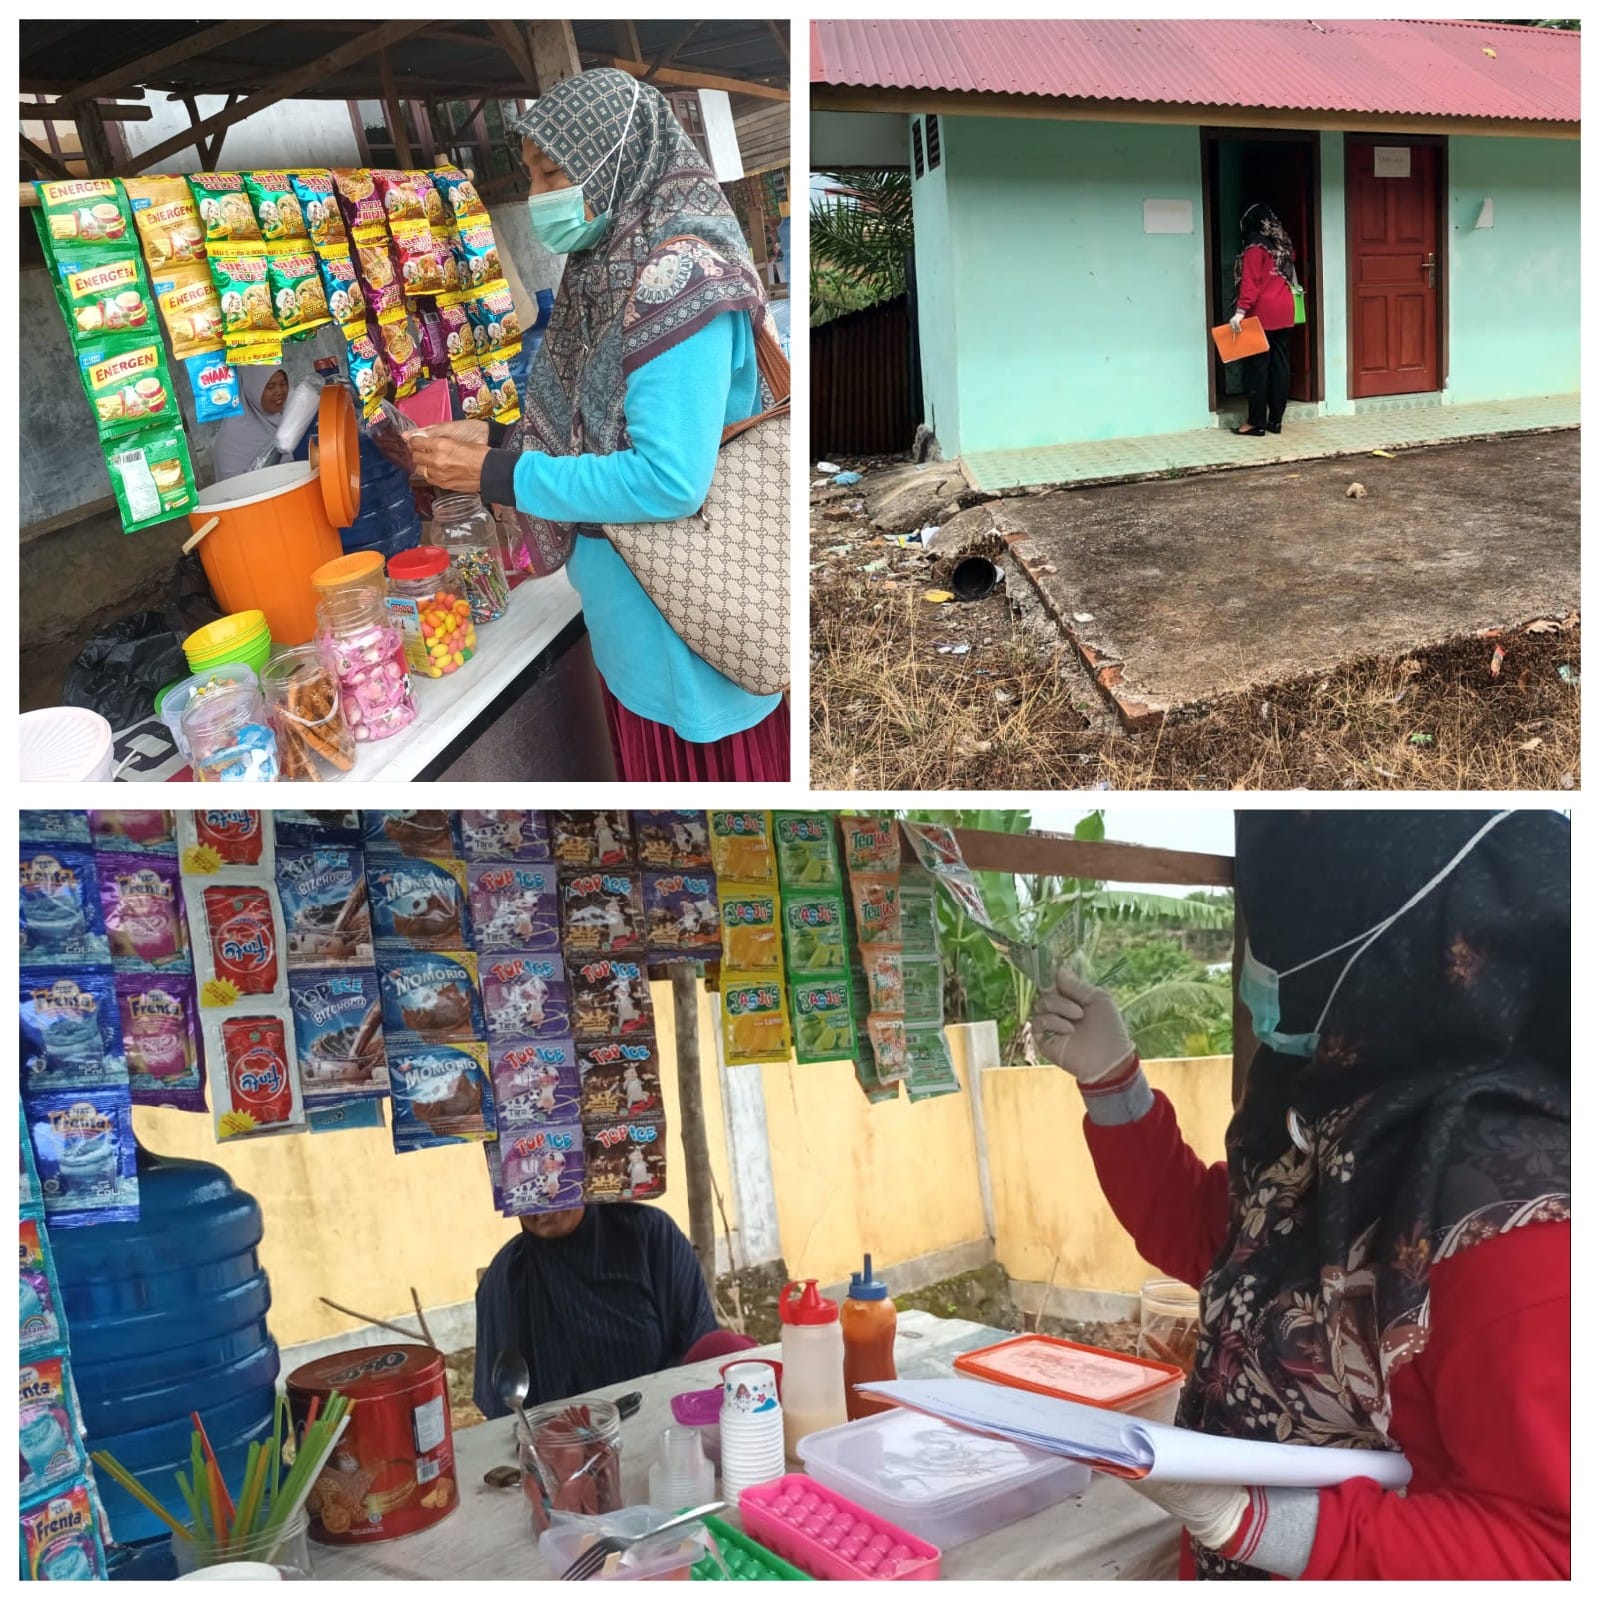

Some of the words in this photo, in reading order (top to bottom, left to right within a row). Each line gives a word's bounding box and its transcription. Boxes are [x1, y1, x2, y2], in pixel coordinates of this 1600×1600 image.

[48, 180, 111, 200] ENERGEN
[145, 205, 195, 227] ENERGEN
[74, 268, 134, 293] ENERGEN
[94, 353, 155, 384] ENERGEN
[281, 853, 316, 882] TOP
[313, 850, 350, 868] ICE
[385, 871, 456, 900] MOMORIO
[480, 868, 516, 892] TOP
[515, 869, 546, 890] ICE
[572, 873, 603, 897] TOP
[603, 874, 633, 896] ICE
[655, 875, 684, 896] TOP
[684, 875, 710, 895] ICE
[395, 968, 468, 997] MOMORIO
[491, 959, 524, 983] TOP
[524, 960, 555, 979] ICE
[581, 960, 610, 982] TOP
[611, 960, 640, 978] ICE
[294, 982, 332, 1012] TOP
[329, 976, 364, 995] ICE
[132, 999, 182, 1018] Frenta
[505, 1045, 537, 1070] TOP
[536, 1047, 567, 1066] ICE
[589, 1044, 620, 1066] TOP
[619, 1043, 651, 1062] ICE
[405, 1059, 478, 1089] MOMORIO
[514, 1131, 545, 1156] TOP
[544, 1131, 573, 1150] ICE
[596, 1124, 628, 1149] TOP
[628, 1124, 658, 1143] ICE
[20, 1382, 51, 1400] nta
[35, 1511, 82, 1543] Frenta
